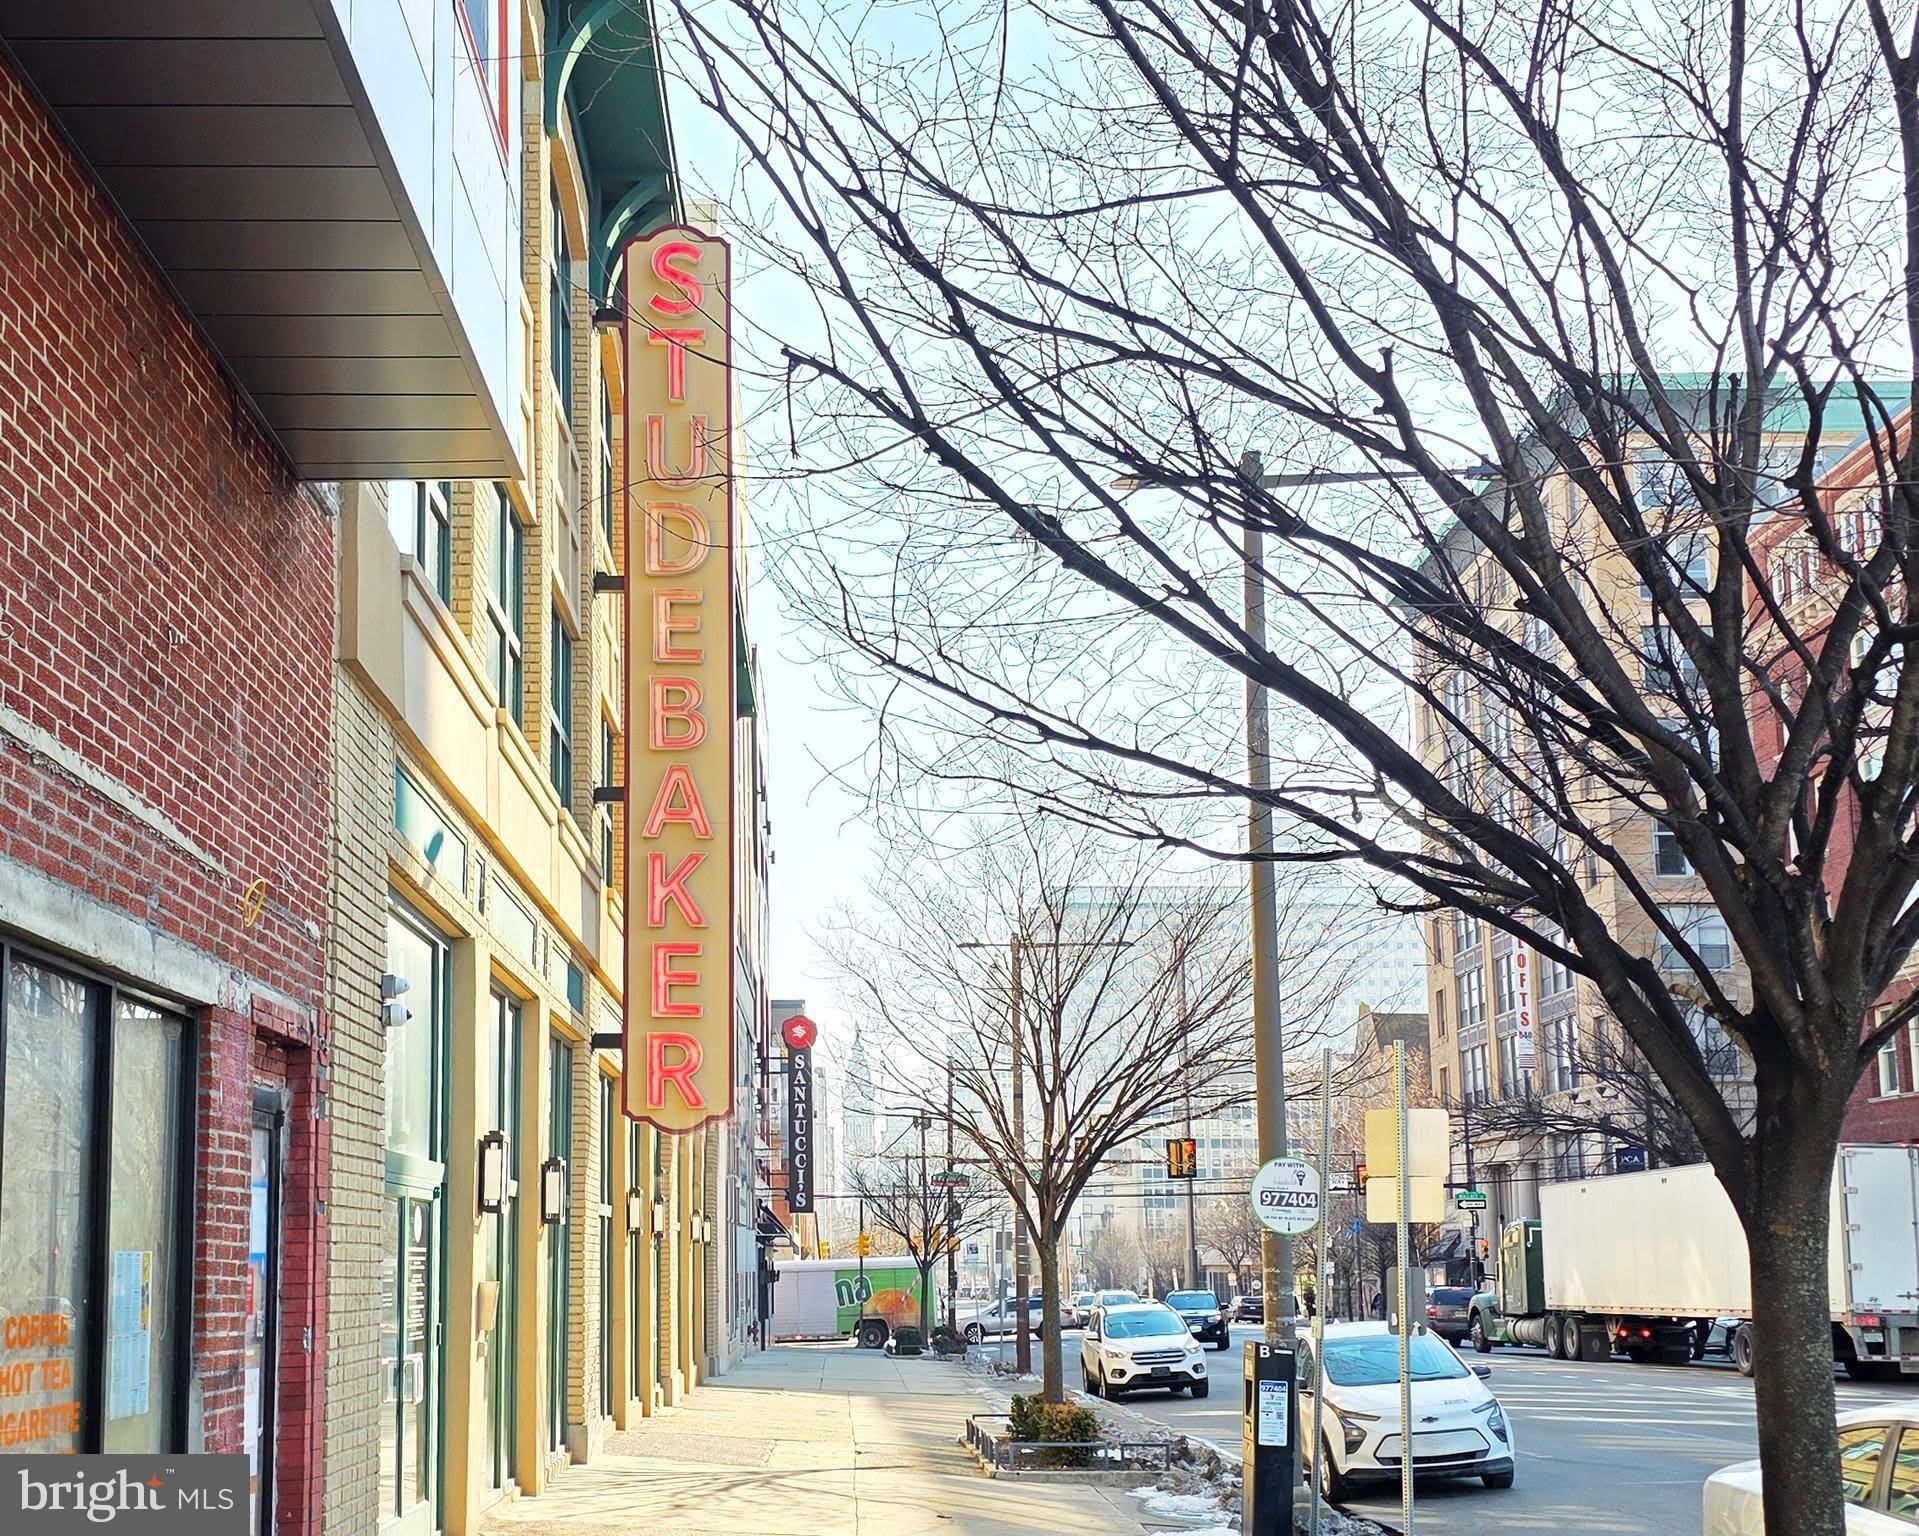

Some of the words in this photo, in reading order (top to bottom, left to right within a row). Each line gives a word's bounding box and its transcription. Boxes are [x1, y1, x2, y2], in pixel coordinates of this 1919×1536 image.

[642, 241, 714, 1110] STUDEBAKER
[1517, 936, 1530, 1027] LOFTS
[793, 1054, 808, 1208] SANTUCCI'S
[1261, 1191, 1317, 1208] 977404
[5, 1314, 69, 1350] COFFEE
[1260, 1345, 1270, 1358] B
[0, 1363, 34, 1398] HOT
[41, 1359, 71, 1391] TEA
